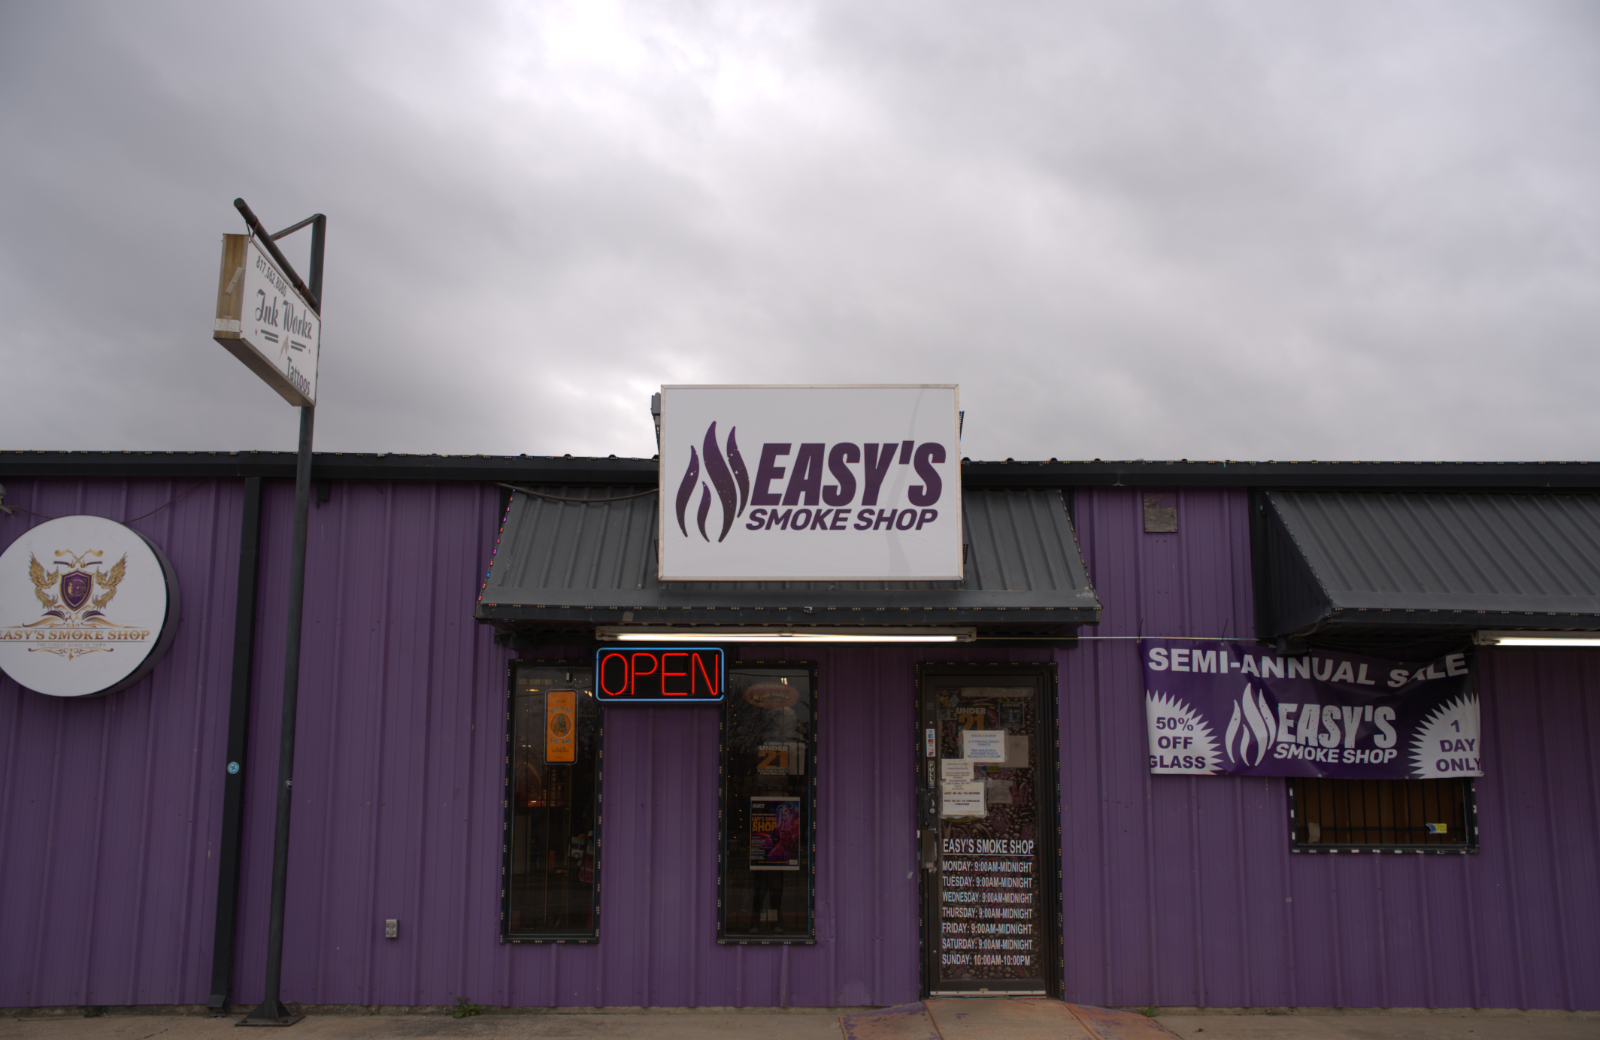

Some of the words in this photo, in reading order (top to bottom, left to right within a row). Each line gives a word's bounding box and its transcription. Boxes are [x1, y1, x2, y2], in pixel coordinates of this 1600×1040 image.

[255, 288, 279, 328] Ink
[282, 299, 313, 340] Workz
[286, 356, 311, 396] Tattoos
[750, 440, 947, 507] EASY'S
[745, 508, 852, 531] SMOKE
[853, 508, 939, 531] SHOP
[48, 629, 104, 641] SMOKE
[107, 630, 150, 641] SHOP
[600, 652, 719, 696] OPEN
[1147, 647, 1376, 686] SEMI-ANNUAL
[550, 706, 573, 715] ZIG-ZAG
[958, 714, 985, 730] 21
[1155, 716, 1195, 732] 50%
[1275, 702, 1397, 750] EASY'S
[1450, 718, 1460, 733] 1
[1157, 735, 1194, 750] OFF
[1439, 738, 1476, 753] DAY
[756, 750, 789, 769] 21
[1273, 742, 1339, 762] SMOKE
[1341, 747, 1398, 764] SHOP
[1149, 755, 1207, 770] GLASS
[1435, 757, 1482, 772] ONLY
[752, 821, 778, 833] SHOP
[942, 838, 975, 854] EASY'S
[976, 839, 1008, 854] SMOKE
[1009, 840, 1035, 854] SHOP
[942, 860, 973, 872] MONDAY:
[974, 861, 1033, 873] 9:00AM-MIDNIGHT
[942, 876, 975, 887] TUESDAY:
[976, 877, 1033, 888] 9:00AM-MIDNIGHT
[942, 891, 982, 903] WEDNESDAY:
[982, 893, 1033, 904] 9:00AM-MIDNIGHT
[942, 907, 978, 919] THURSDAY:
[978, 908, 1033, 919] 9:00AM-MIDNIGHT
[942, 923, 970, 934] FRIDAY:
[971, 924, 1033, 935] 9:00AM-MIDNIGHT
[942, 939, 978, 950] SATURDAY:
[978, 939, 1033, 951] 9:00AM-MIDNIGHT
[942, 954, 972, 965] SUNDAY:
[973, 955, 1031, 966] 10:00AM-10:00PM
